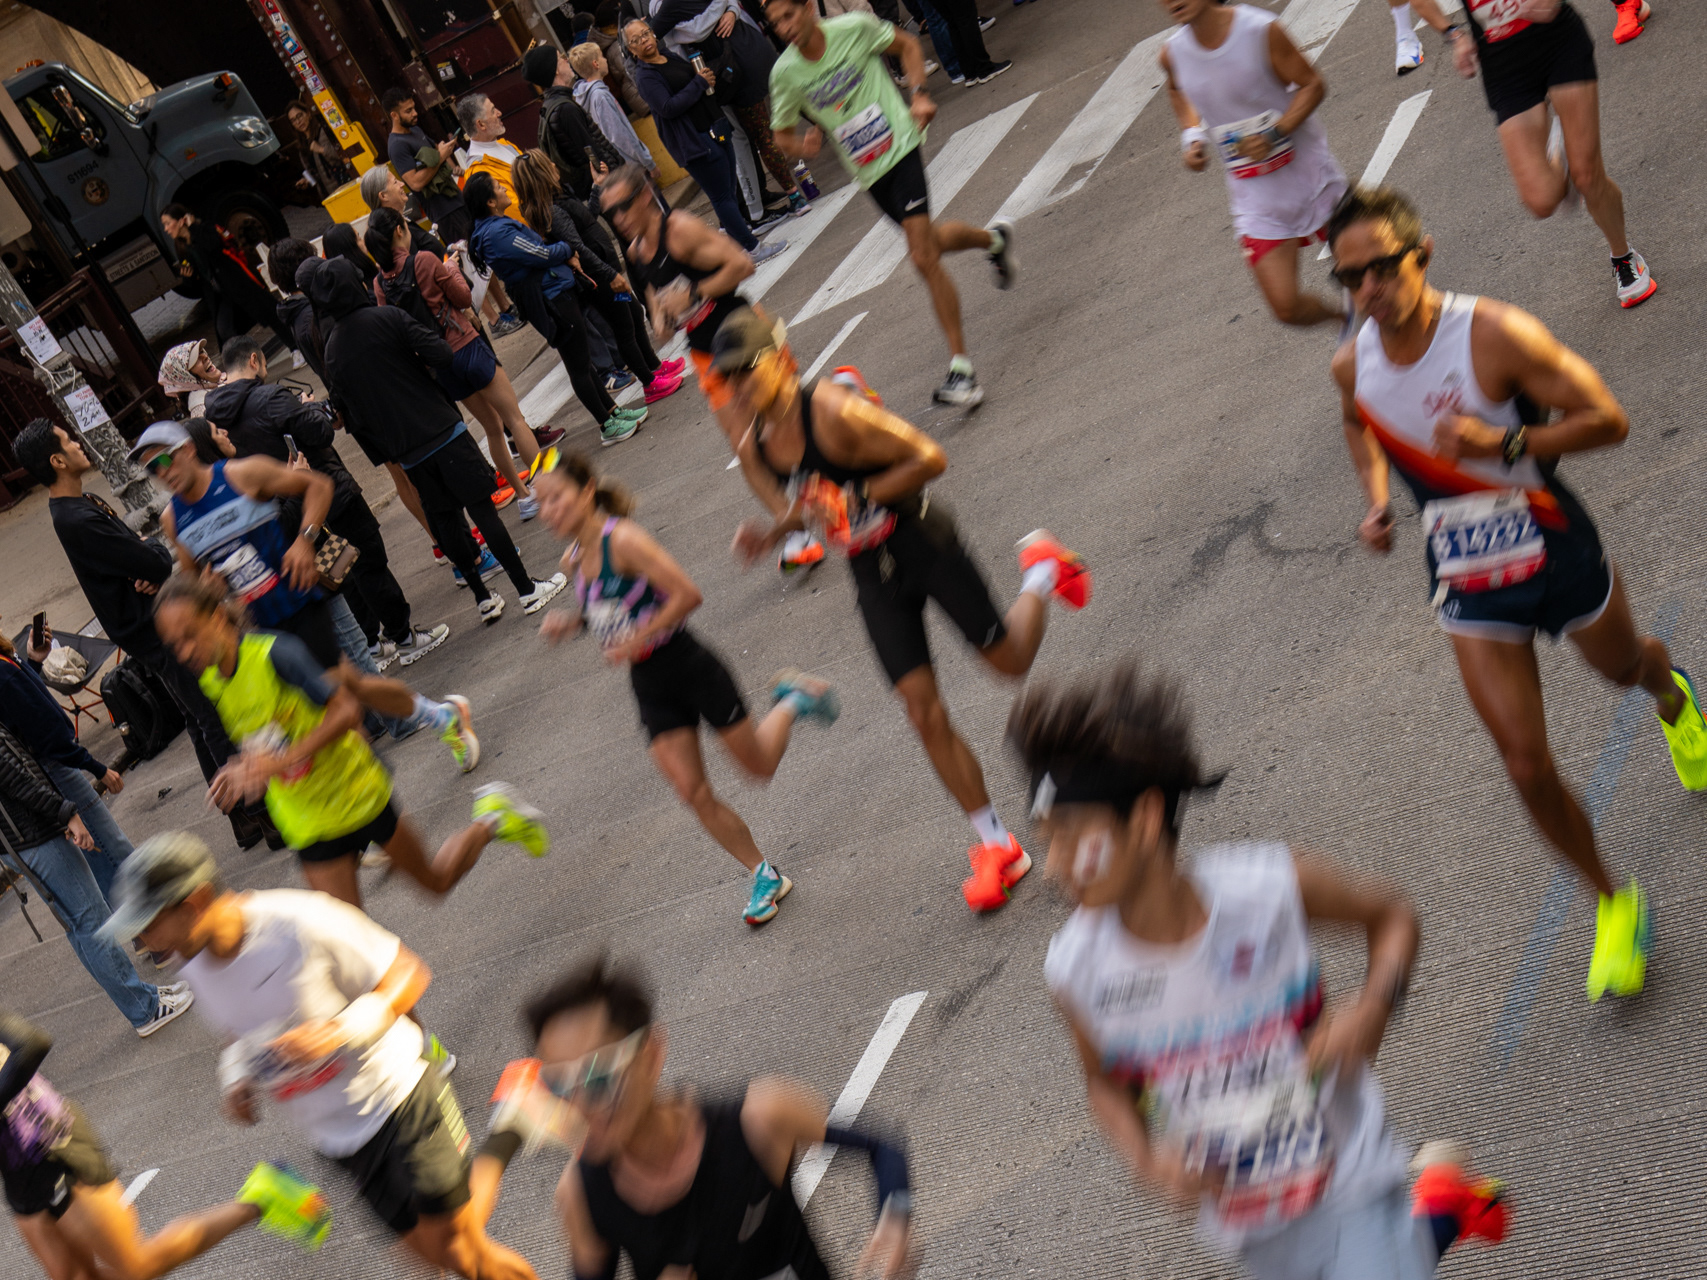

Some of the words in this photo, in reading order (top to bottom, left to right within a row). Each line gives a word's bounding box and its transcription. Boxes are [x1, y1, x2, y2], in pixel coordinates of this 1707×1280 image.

[67, 160, 99, 184] S11694
[109, 265, 129, 280] STREETS
[133, 249, 159, 267] SANITATION
